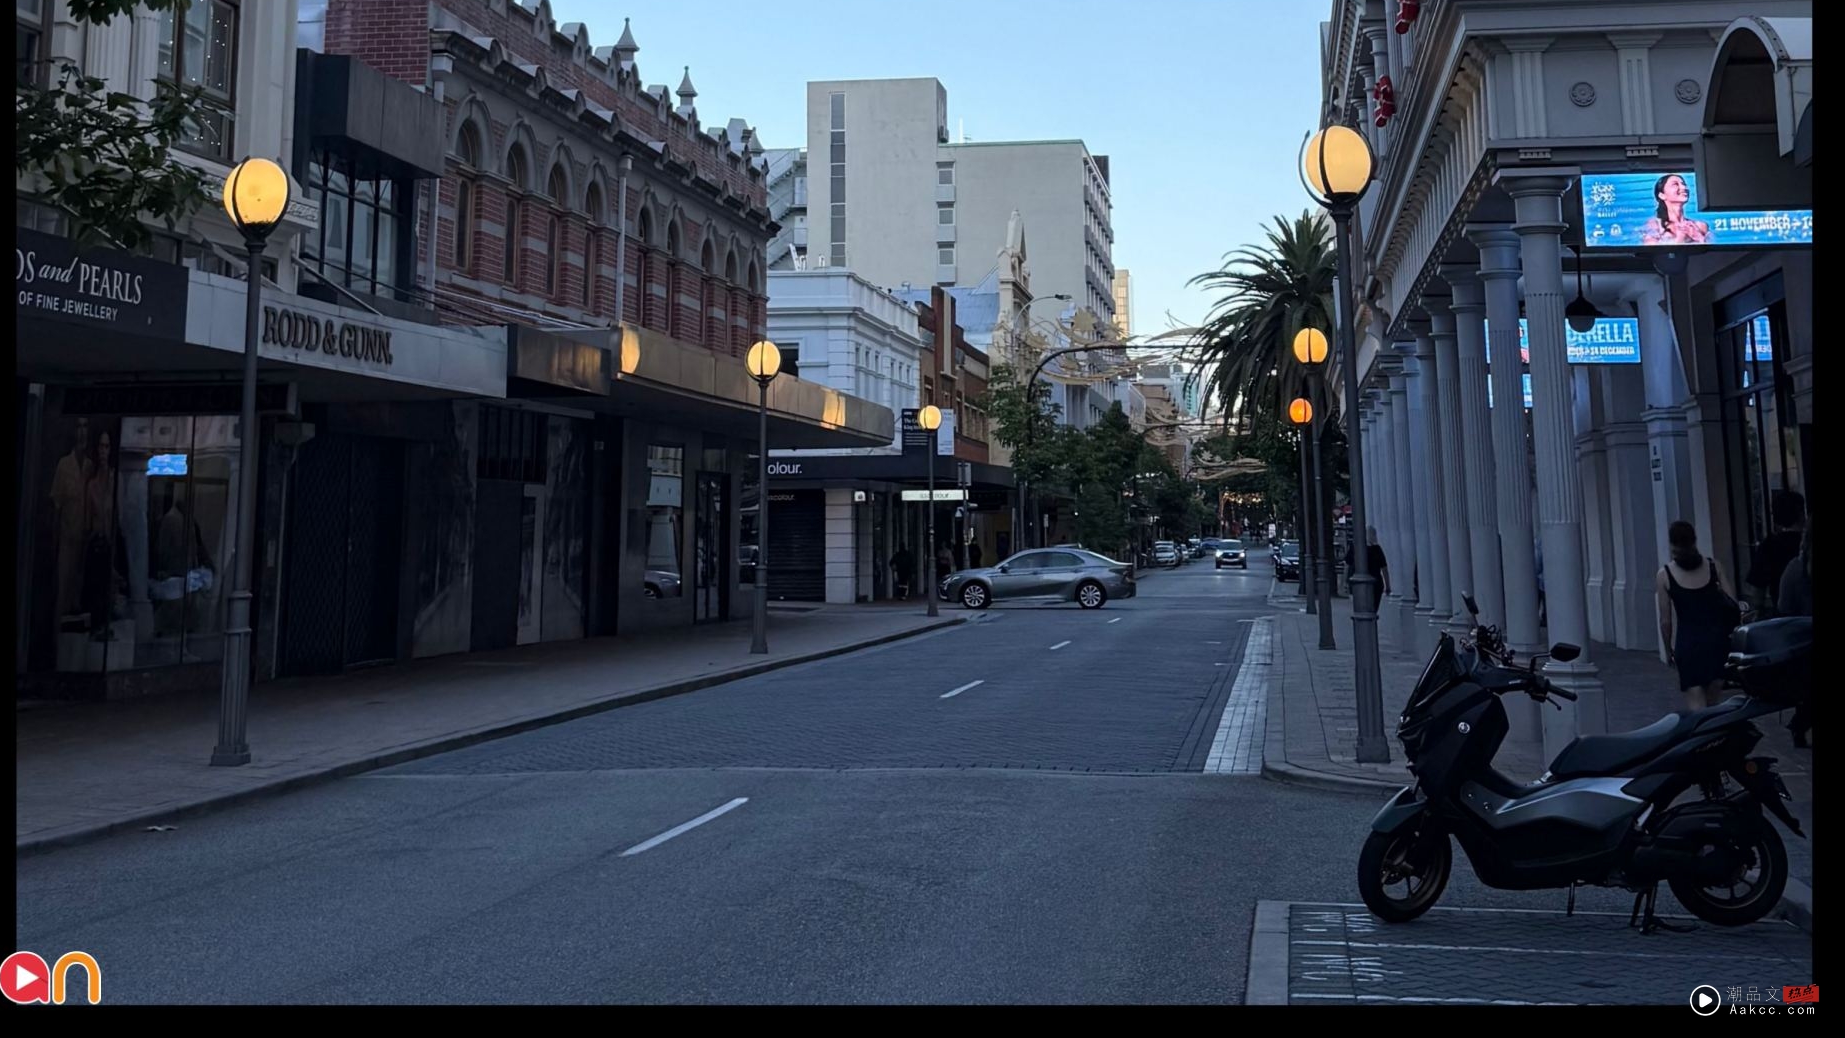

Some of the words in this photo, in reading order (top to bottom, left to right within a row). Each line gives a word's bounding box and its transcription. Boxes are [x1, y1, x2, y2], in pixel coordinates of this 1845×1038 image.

[1714, 218, 1728, 231] 21
[1730, 216, 1790, 231] NOVEMBER
[38, 256, 79, 283] and
[78, 262, 143, 305] PEARLS
[18, 290, 34, 306] OF
[36, 293, 60, 312] FINE
[61, 298, 119, 322] JEWELLERY
[262, 306, 321, 352] RODD
[322, 318, 338, 355] &
[767, 461, 803, 475] olour.
